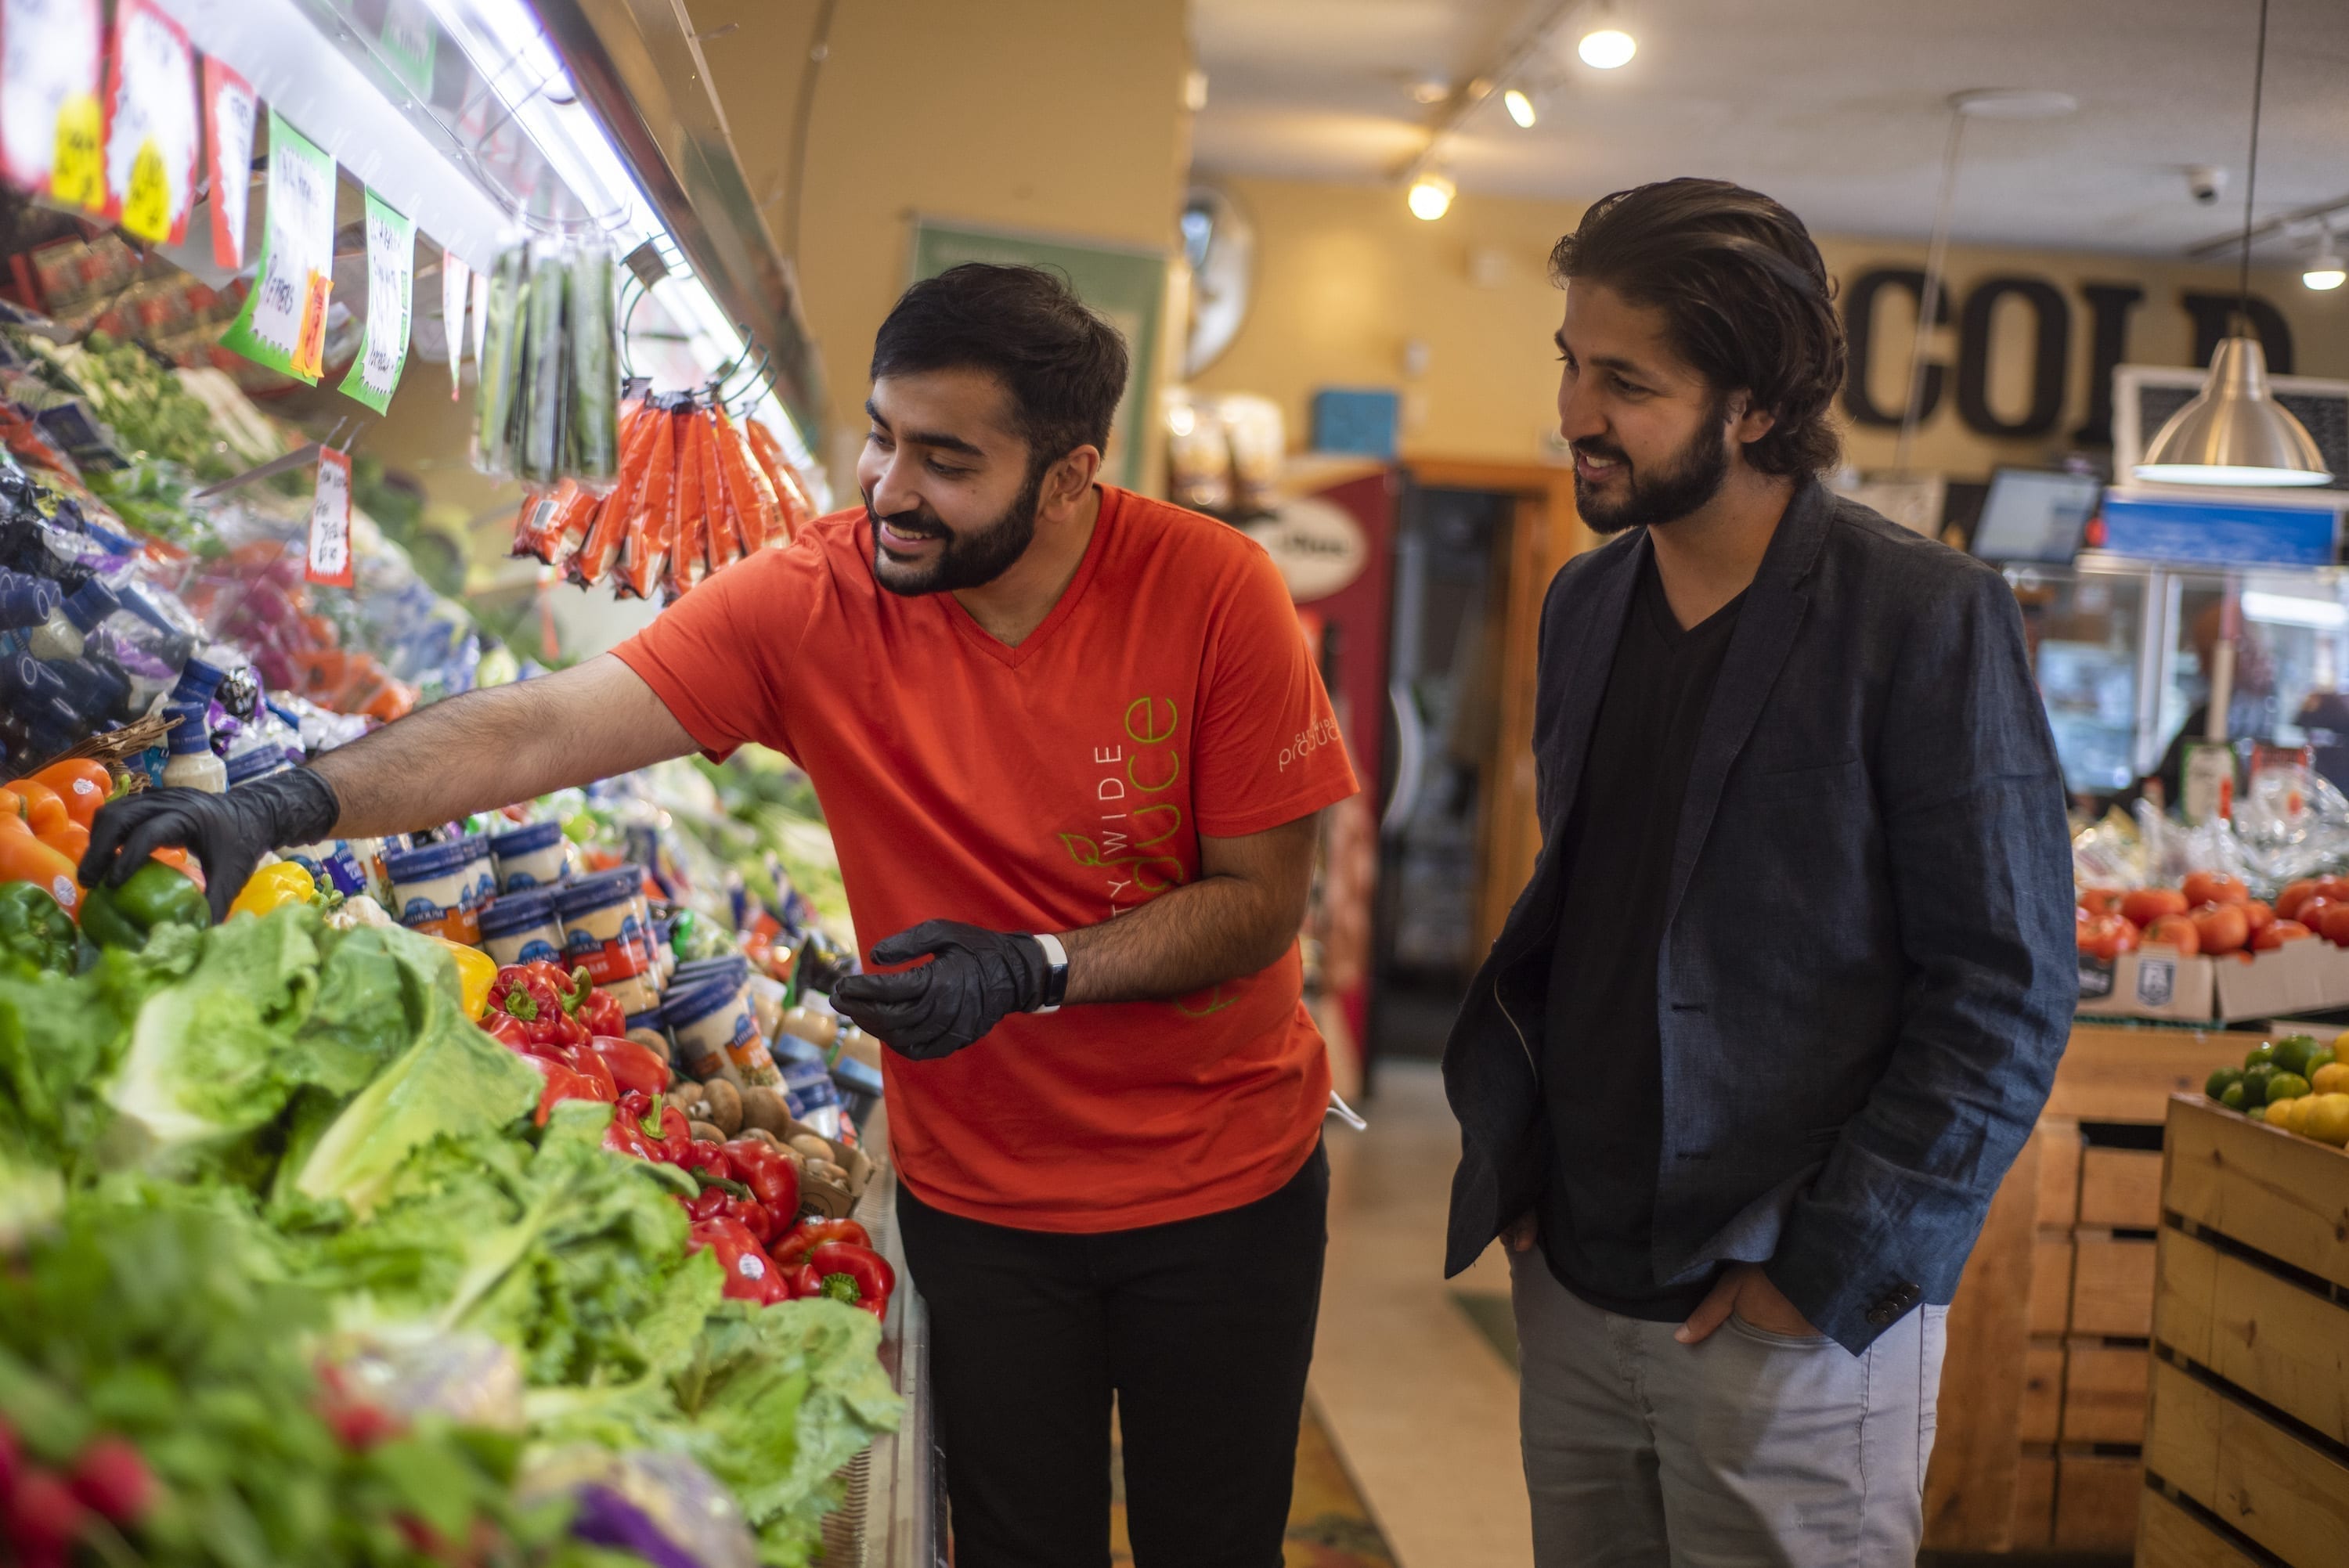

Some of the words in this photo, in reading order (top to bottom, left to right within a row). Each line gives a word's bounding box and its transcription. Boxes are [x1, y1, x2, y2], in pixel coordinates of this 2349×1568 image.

[1279, 723, 1340, 773] produc
[1094, 744, 1128, 856] WIDE
[1108, 878, 1136, 919] TY
